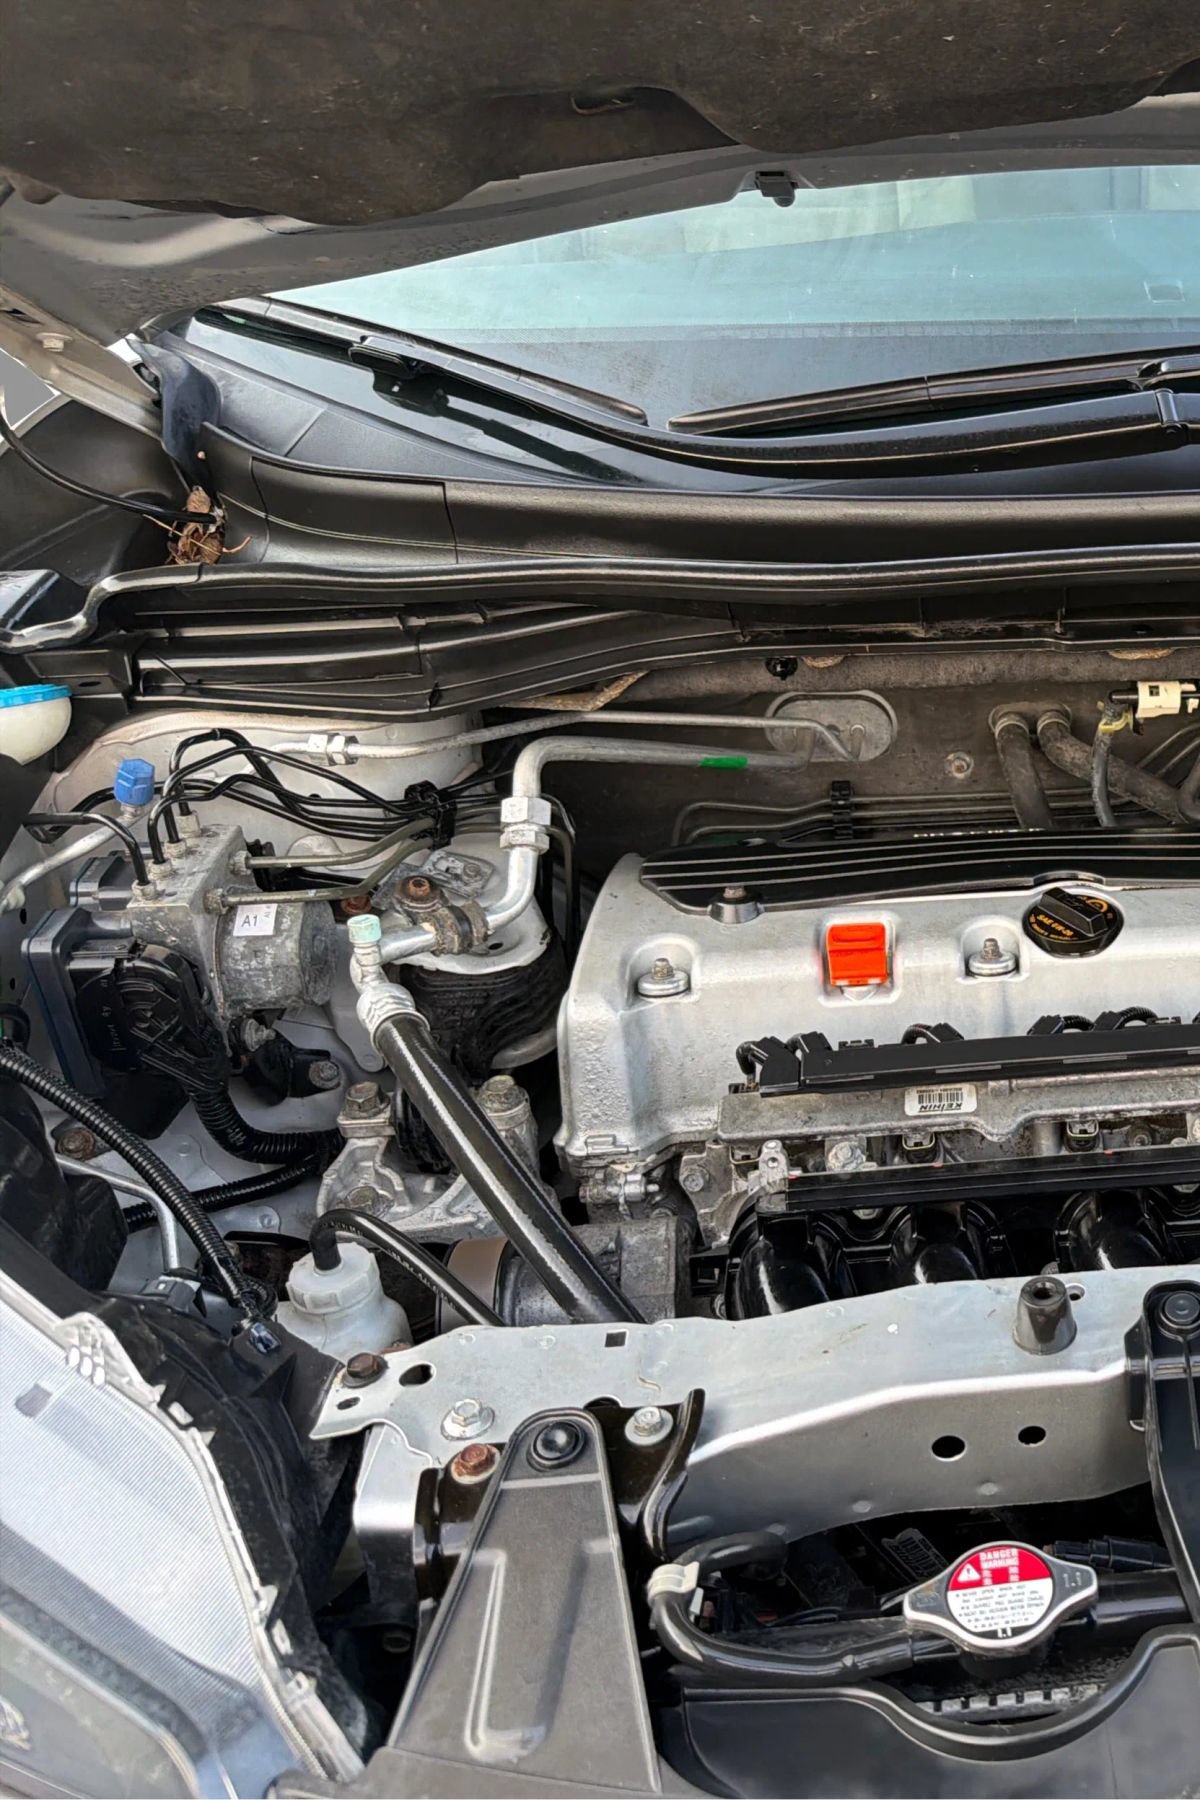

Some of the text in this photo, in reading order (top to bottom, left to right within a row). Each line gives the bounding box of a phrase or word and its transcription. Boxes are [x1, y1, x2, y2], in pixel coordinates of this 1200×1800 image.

[241, 914, 258, 927] A1
[979, 1548, 1019, 1560] DANGER
[981, 1557, 1019, 1569] WARNING
